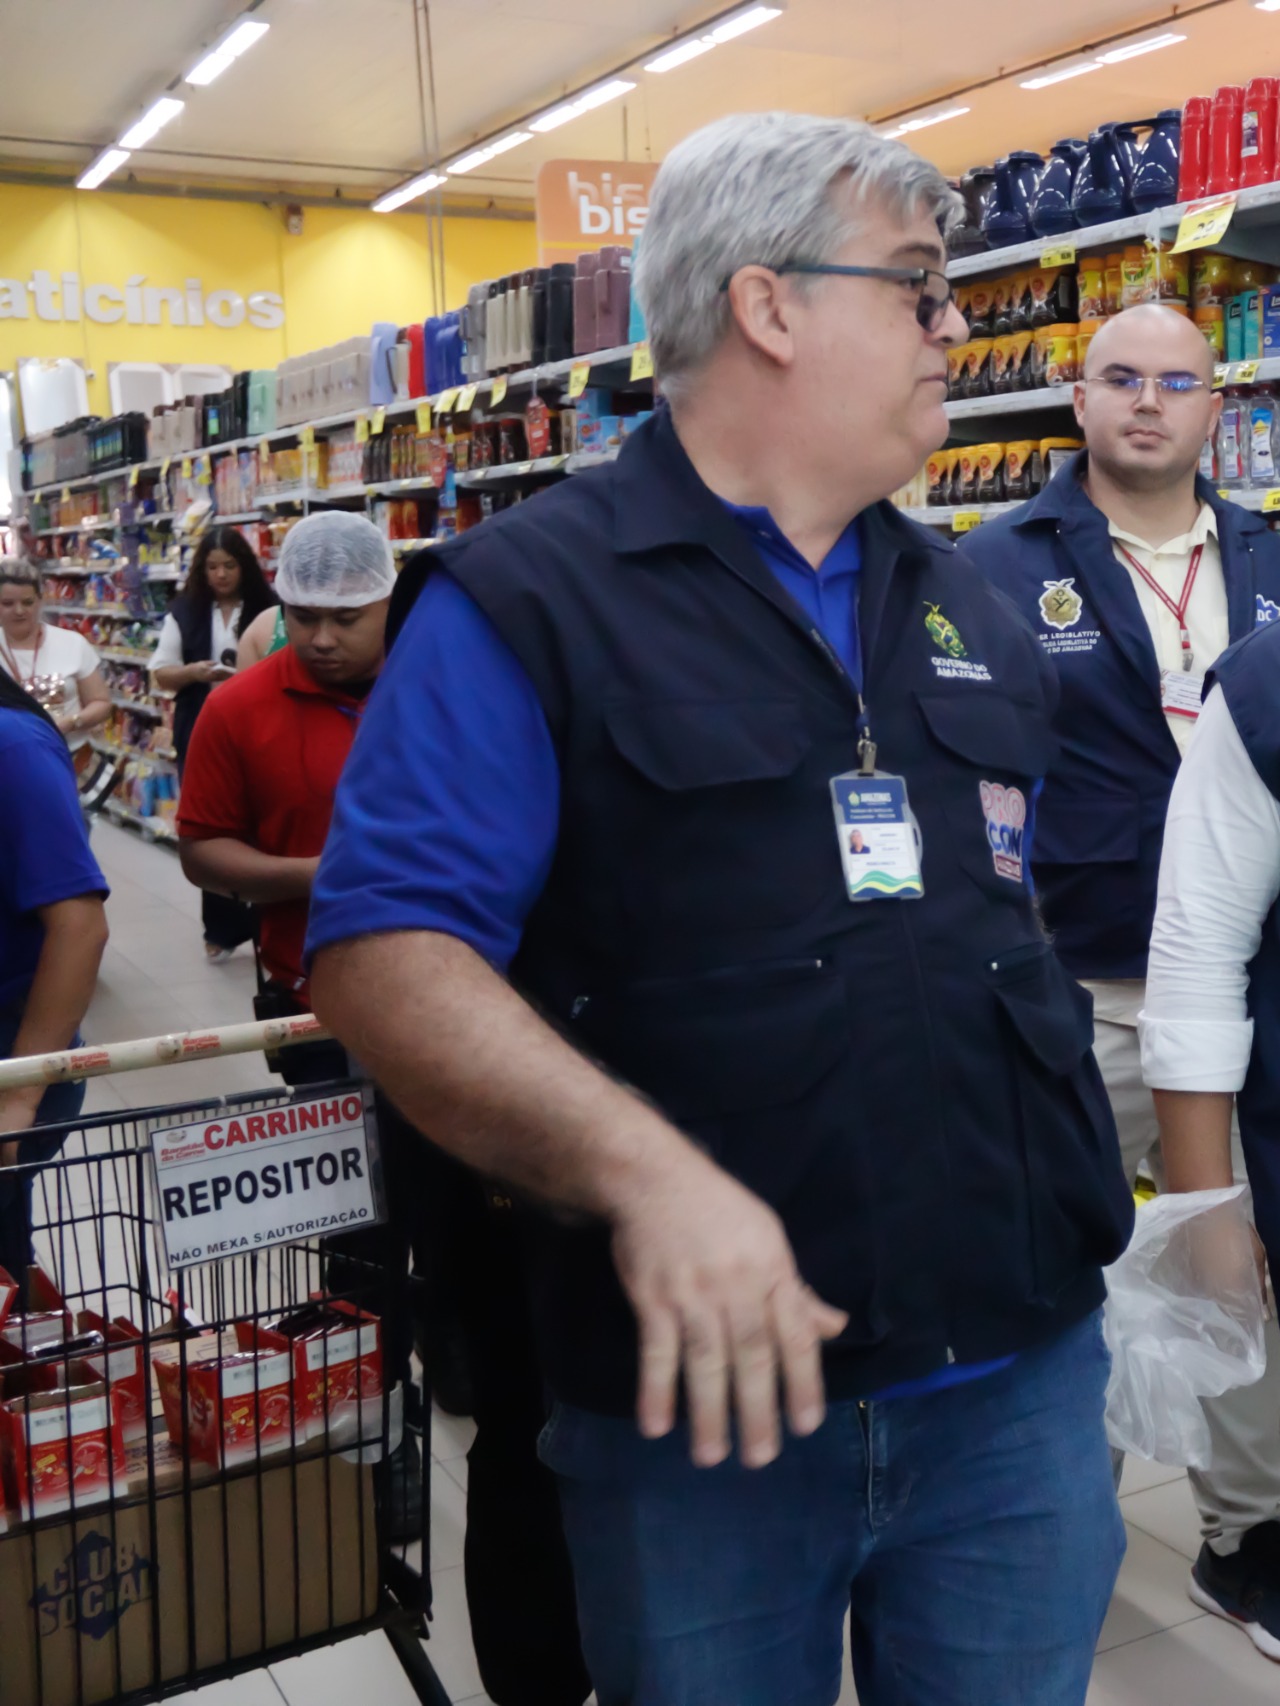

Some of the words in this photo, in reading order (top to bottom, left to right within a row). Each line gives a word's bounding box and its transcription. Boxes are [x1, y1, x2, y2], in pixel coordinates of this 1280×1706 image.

[1256, 609, 1272, 621] DC
[936, 667, 992, 681] AMAZONAS
[203, 1095, 363, 1151] CARRINHO
[162, 1147, 364, 1222] REPOSITOR
[169, 1246, 202, 1264] NÃO
[207, 1236, 249, 1255] MEXA
